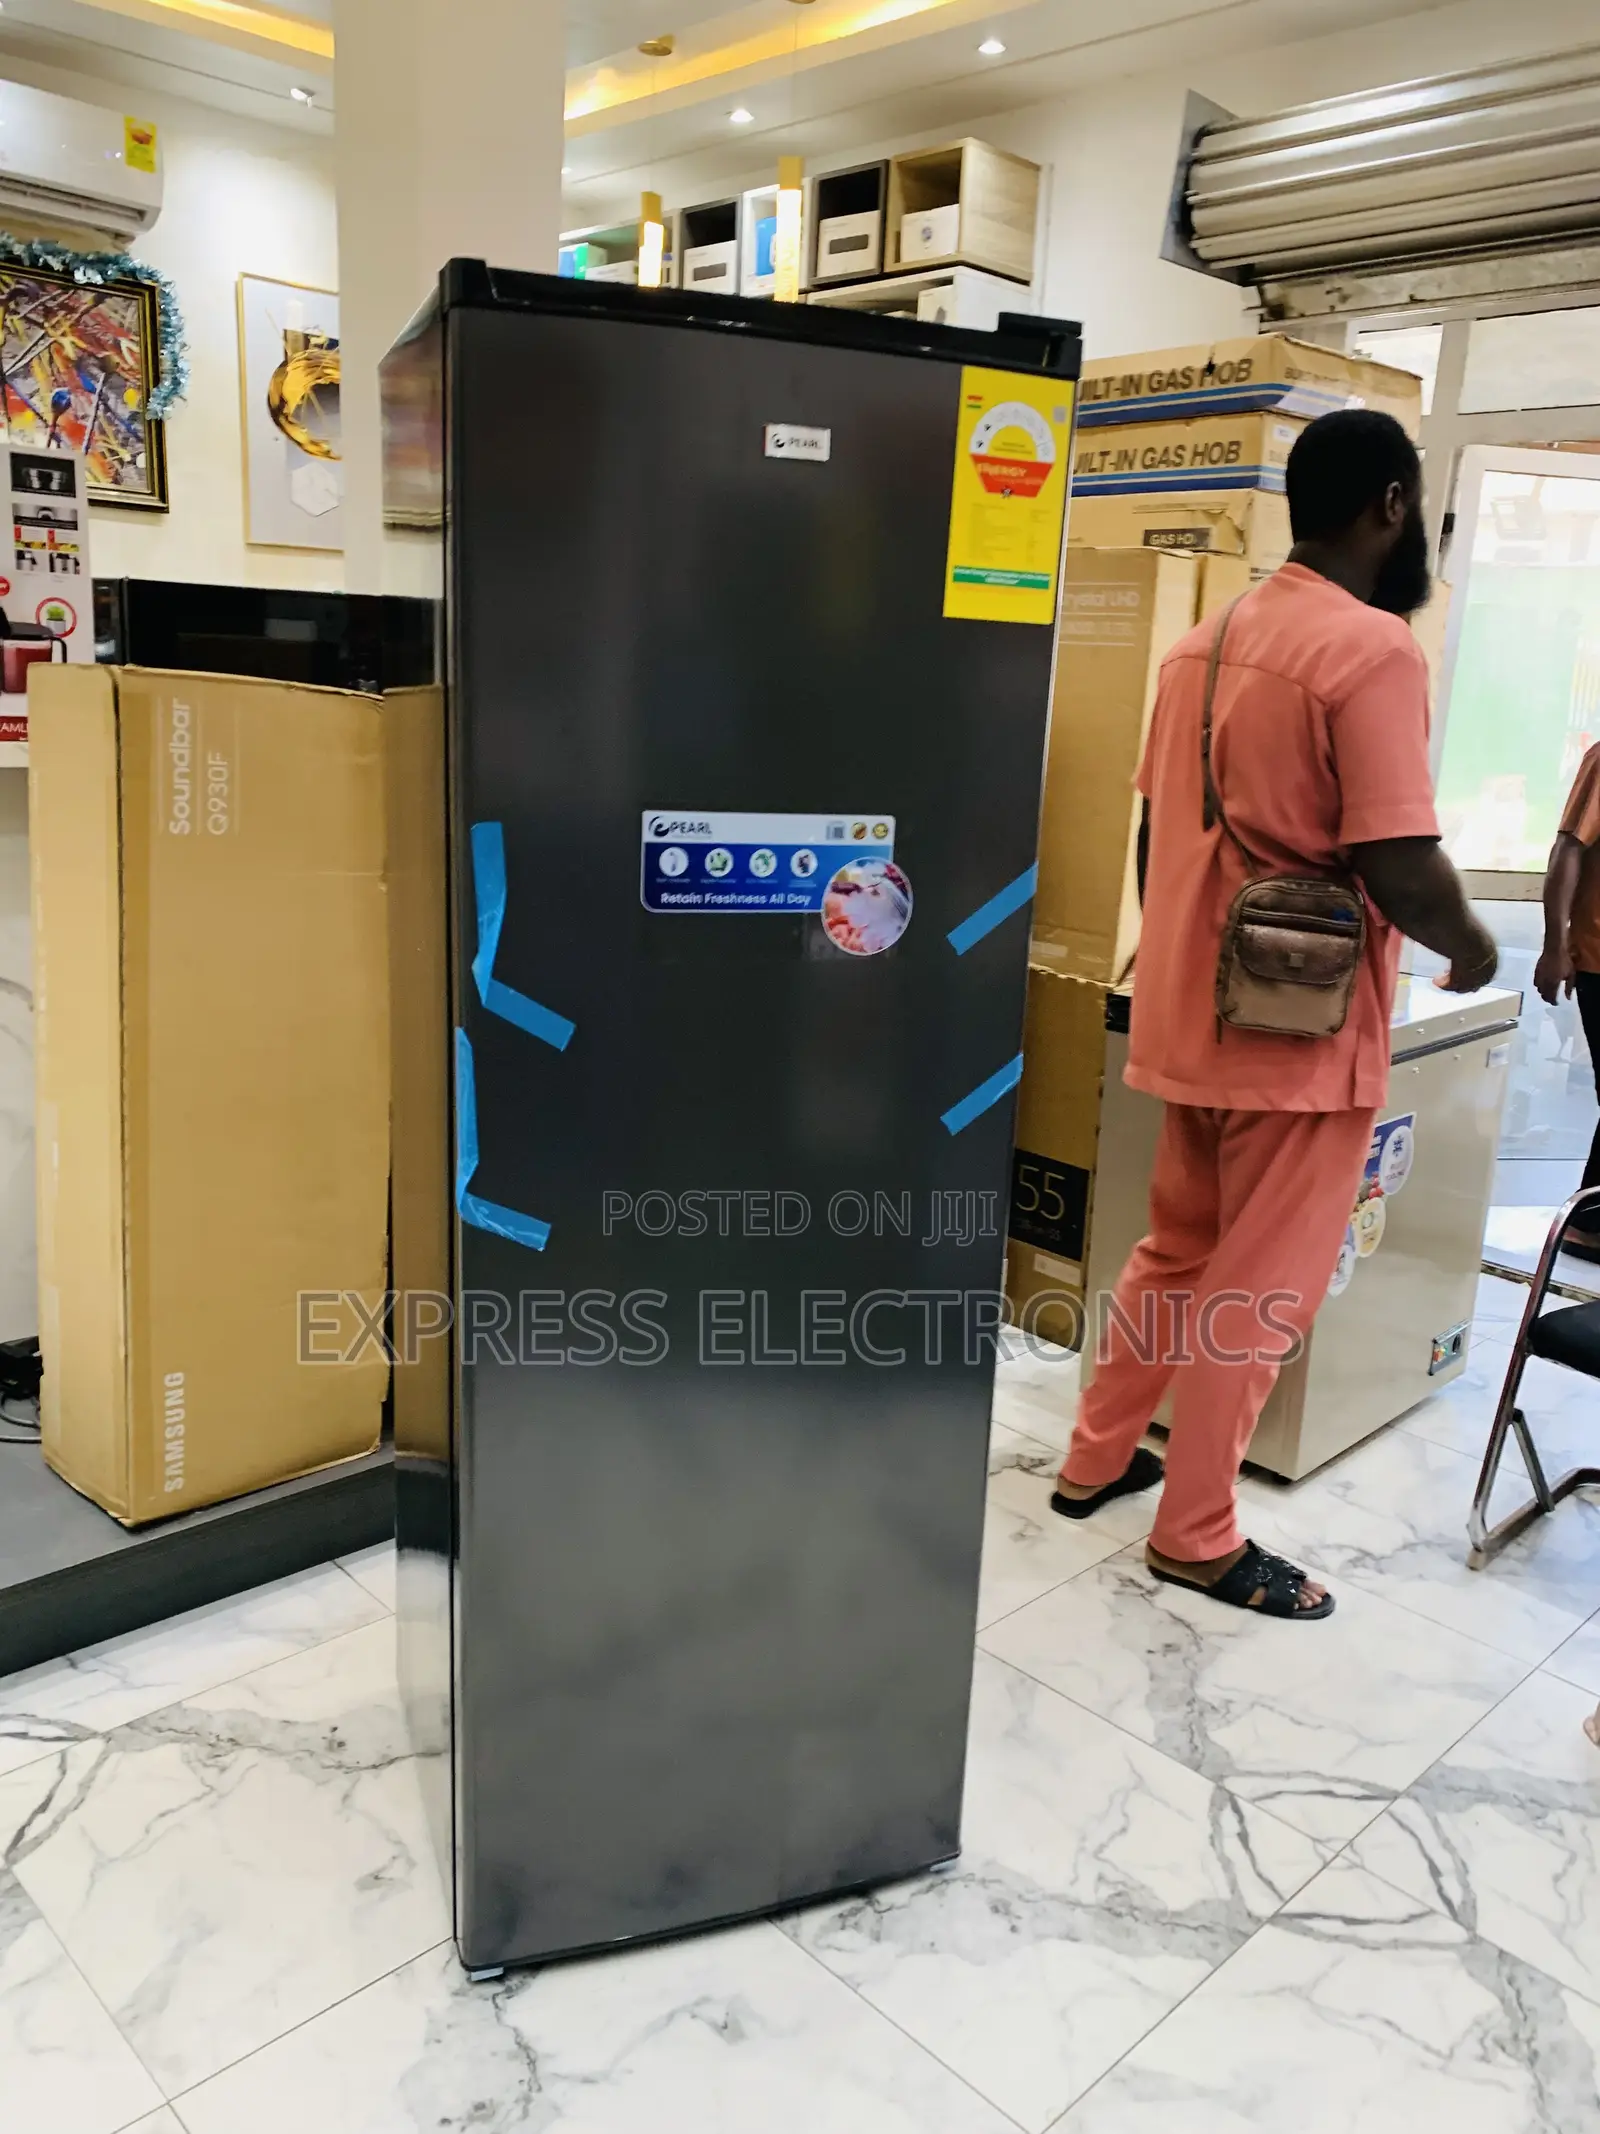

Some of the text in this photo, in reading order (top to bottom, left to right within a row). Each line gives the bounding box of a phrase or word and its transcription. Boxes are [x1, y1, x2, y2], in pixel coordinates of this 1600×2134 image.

[1078, 373, 1143, 401] UILT-IN
[1148, 366, 1194, 393] GAS
[1199, 358, 1253, 387] HOB
[1072, 448, 1138, 475] UILT-IN
[1141, 444, 1186, 470] GAS
[1190, 440, 1242, 466] HOB
[1176, 532, 1196, 545] HO
[1064, 592, 1106, 613] rystal
[168, 697, 192, 835] Soundbar
[207, 750, 229, 835] Q930F
[669, 820, 713, 835] PEARL
[661, 892, 812, 907] Retain Freshness All Day
[1015, 1164, 1066, 1220] 55
[164, 1372, 185, 1493] SAMSUNG
